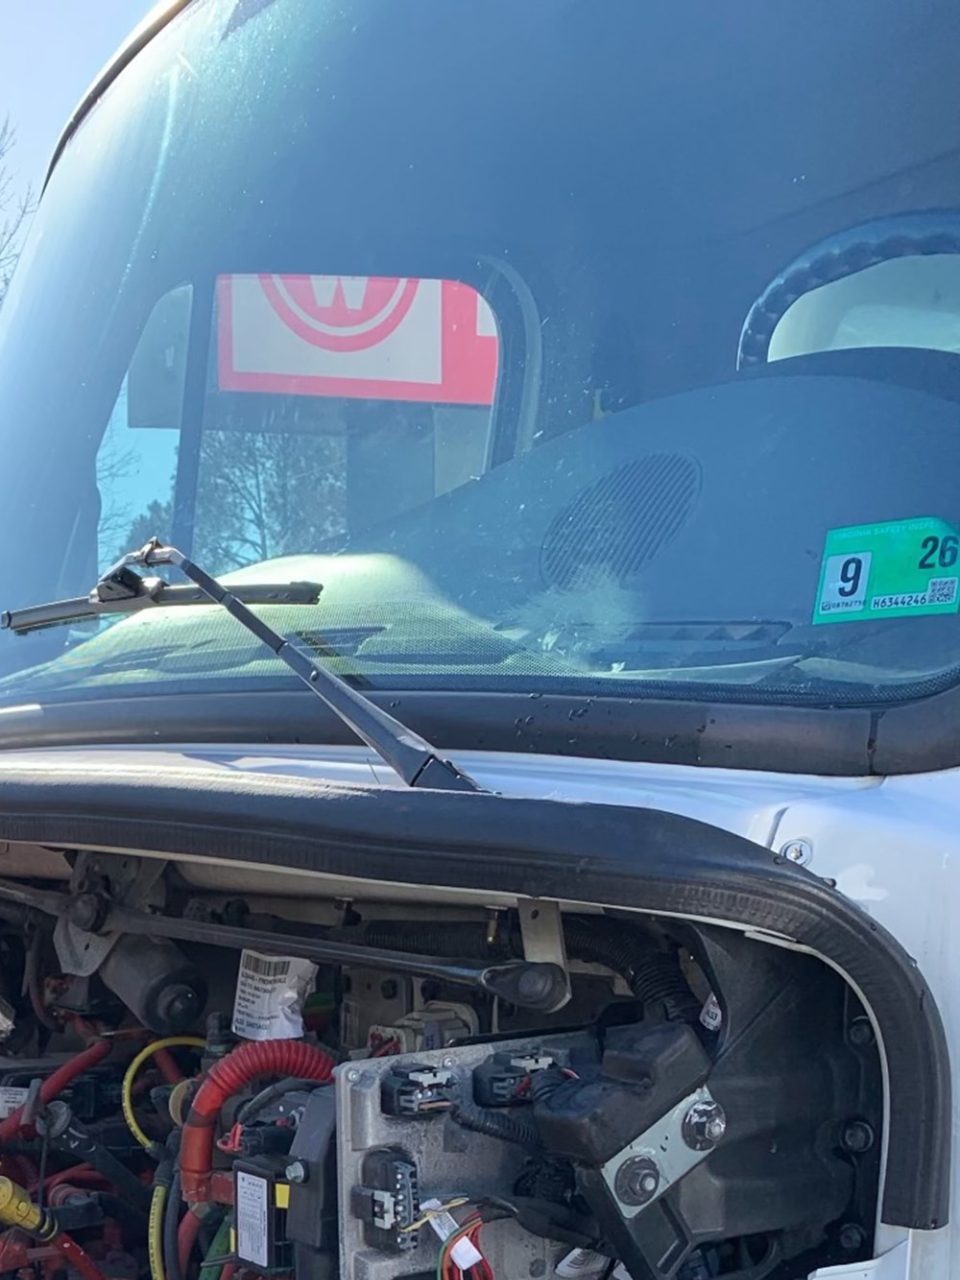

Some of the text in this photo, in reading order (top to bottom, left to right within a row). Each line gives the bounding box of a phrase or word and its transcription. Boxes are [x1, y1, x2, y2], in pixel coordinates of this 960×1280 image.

[874, 525, 906, 535] SAFETY
[918, 535, 959, 569] 26
[838, 557, 862, 597] 9
[872, 594, 927, 609] H6344246
